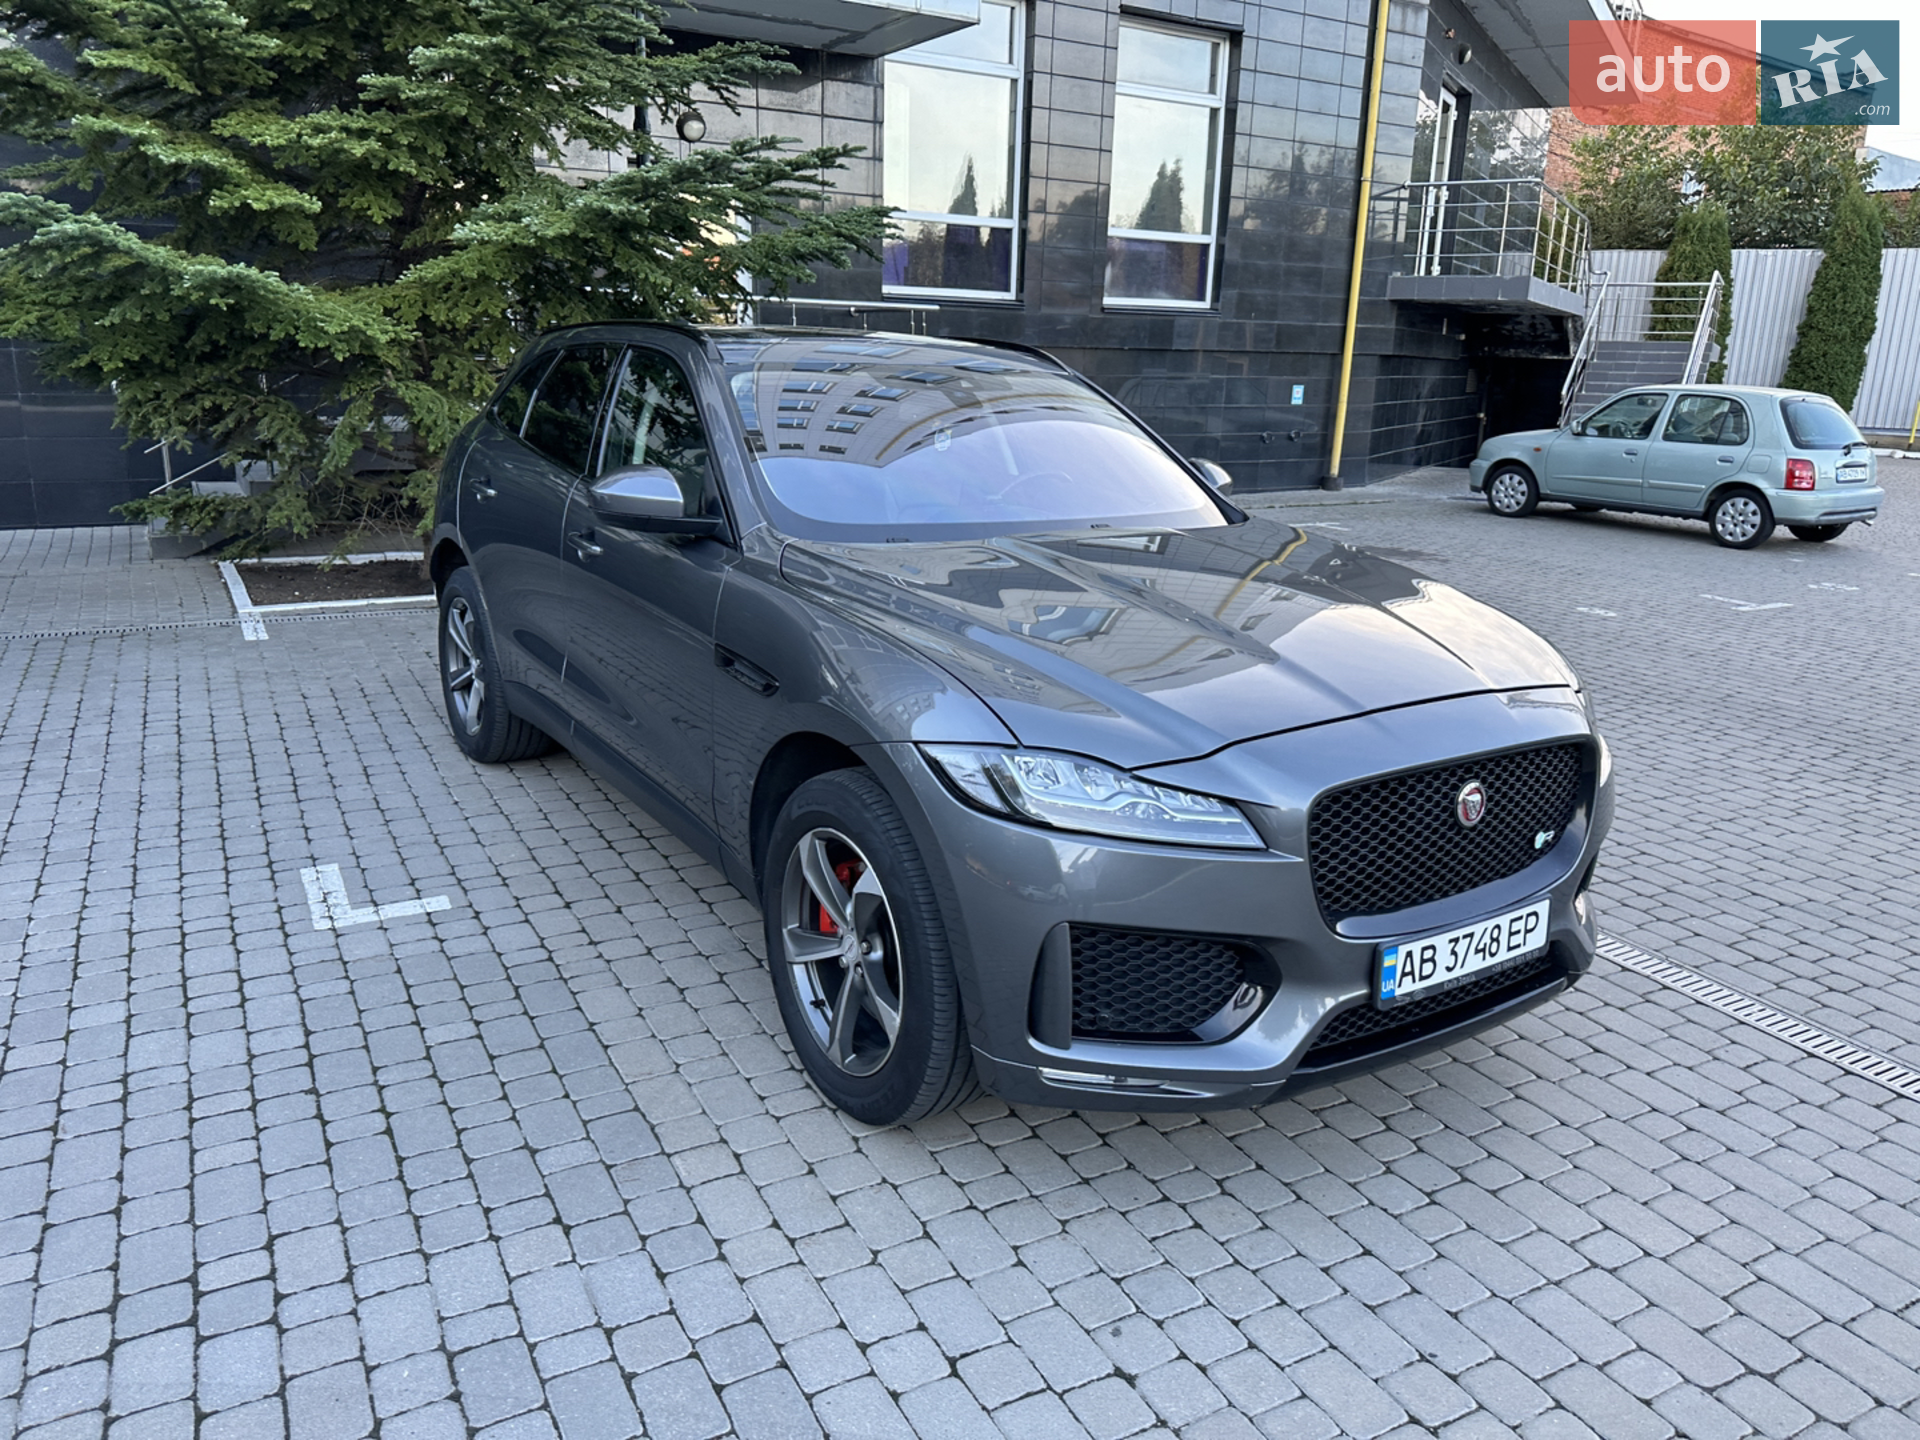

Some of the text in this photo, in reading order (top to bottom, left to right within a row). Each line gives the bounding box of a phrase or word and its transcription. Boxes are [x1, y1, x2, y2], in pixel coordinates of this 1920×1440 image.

[1397, 944, 1437, 989] AB
[1444, 923, 1502, 973] 3748
[1506, 910, 1540, 953] EP
[1382, 978, 1395, 993] UA
